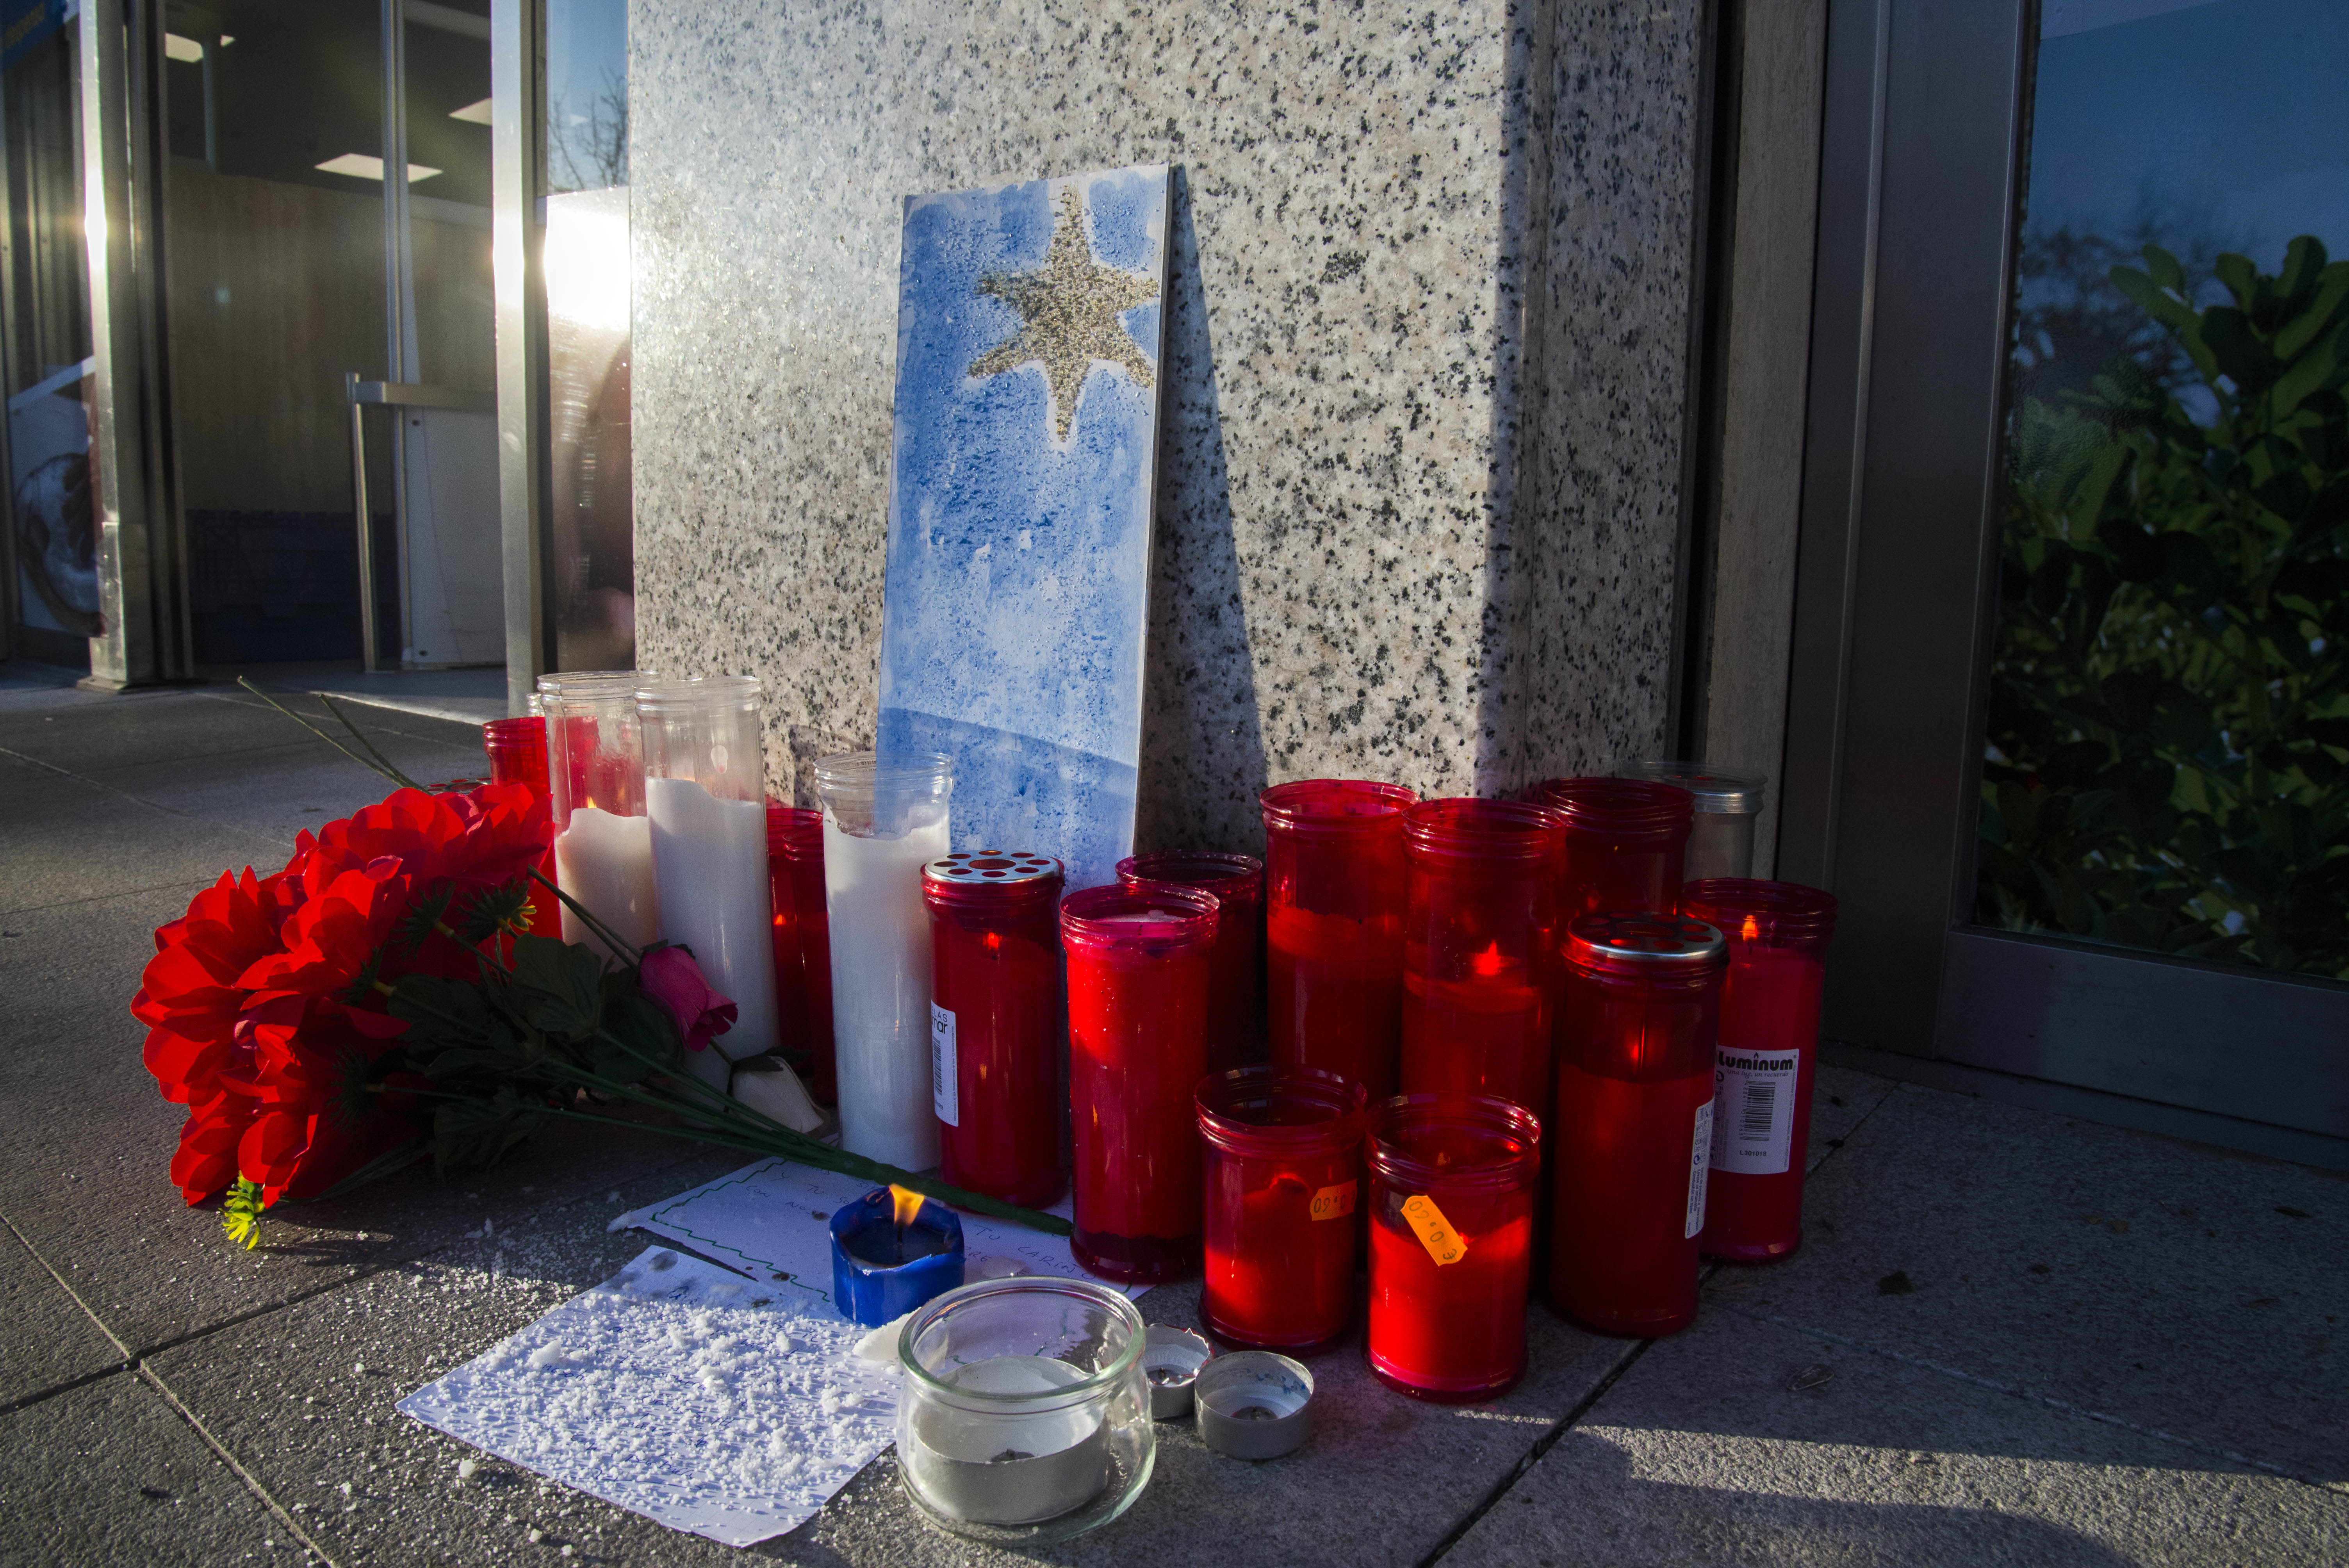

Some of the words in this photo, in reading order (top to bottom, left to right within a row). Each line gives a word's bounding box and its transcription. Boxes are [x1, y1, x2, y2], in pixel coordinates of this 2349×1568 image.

[1718, 1051, 1793, 1071] Luminum
[746, 1185, 771, 1197] CON
[1408, 1201, 1444, 1243] 0,60
[1443, 1248, 1457, 1260] €
